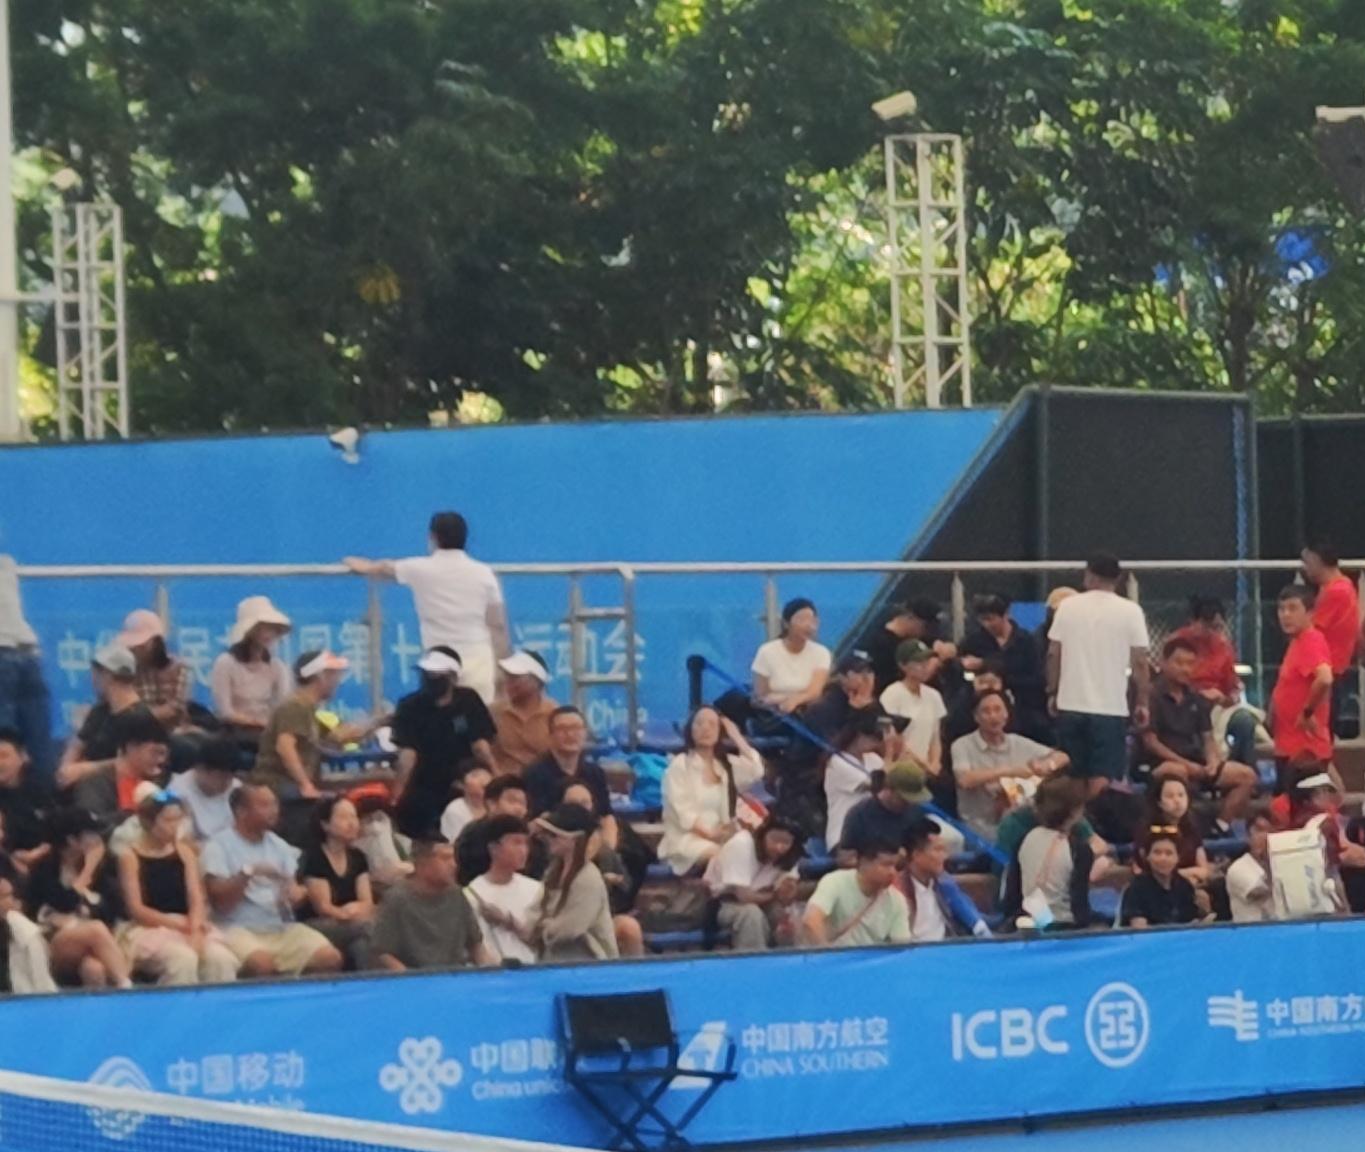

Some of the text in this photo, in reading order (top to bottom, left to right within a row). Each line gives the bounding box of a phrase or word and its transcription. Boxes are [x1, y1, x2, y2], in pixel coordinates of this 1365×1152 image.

[742, 1016, 889, 1055] 中国南方航空
[952, 1004, 1069, 1062] ICBC
[166, 1049, 304, 1096] 中国移动
[470, 1036, 564, 1074] 中国联
[741, 1056, 795, 1079] CHINA
[472, 1079, 522, 1101] China
